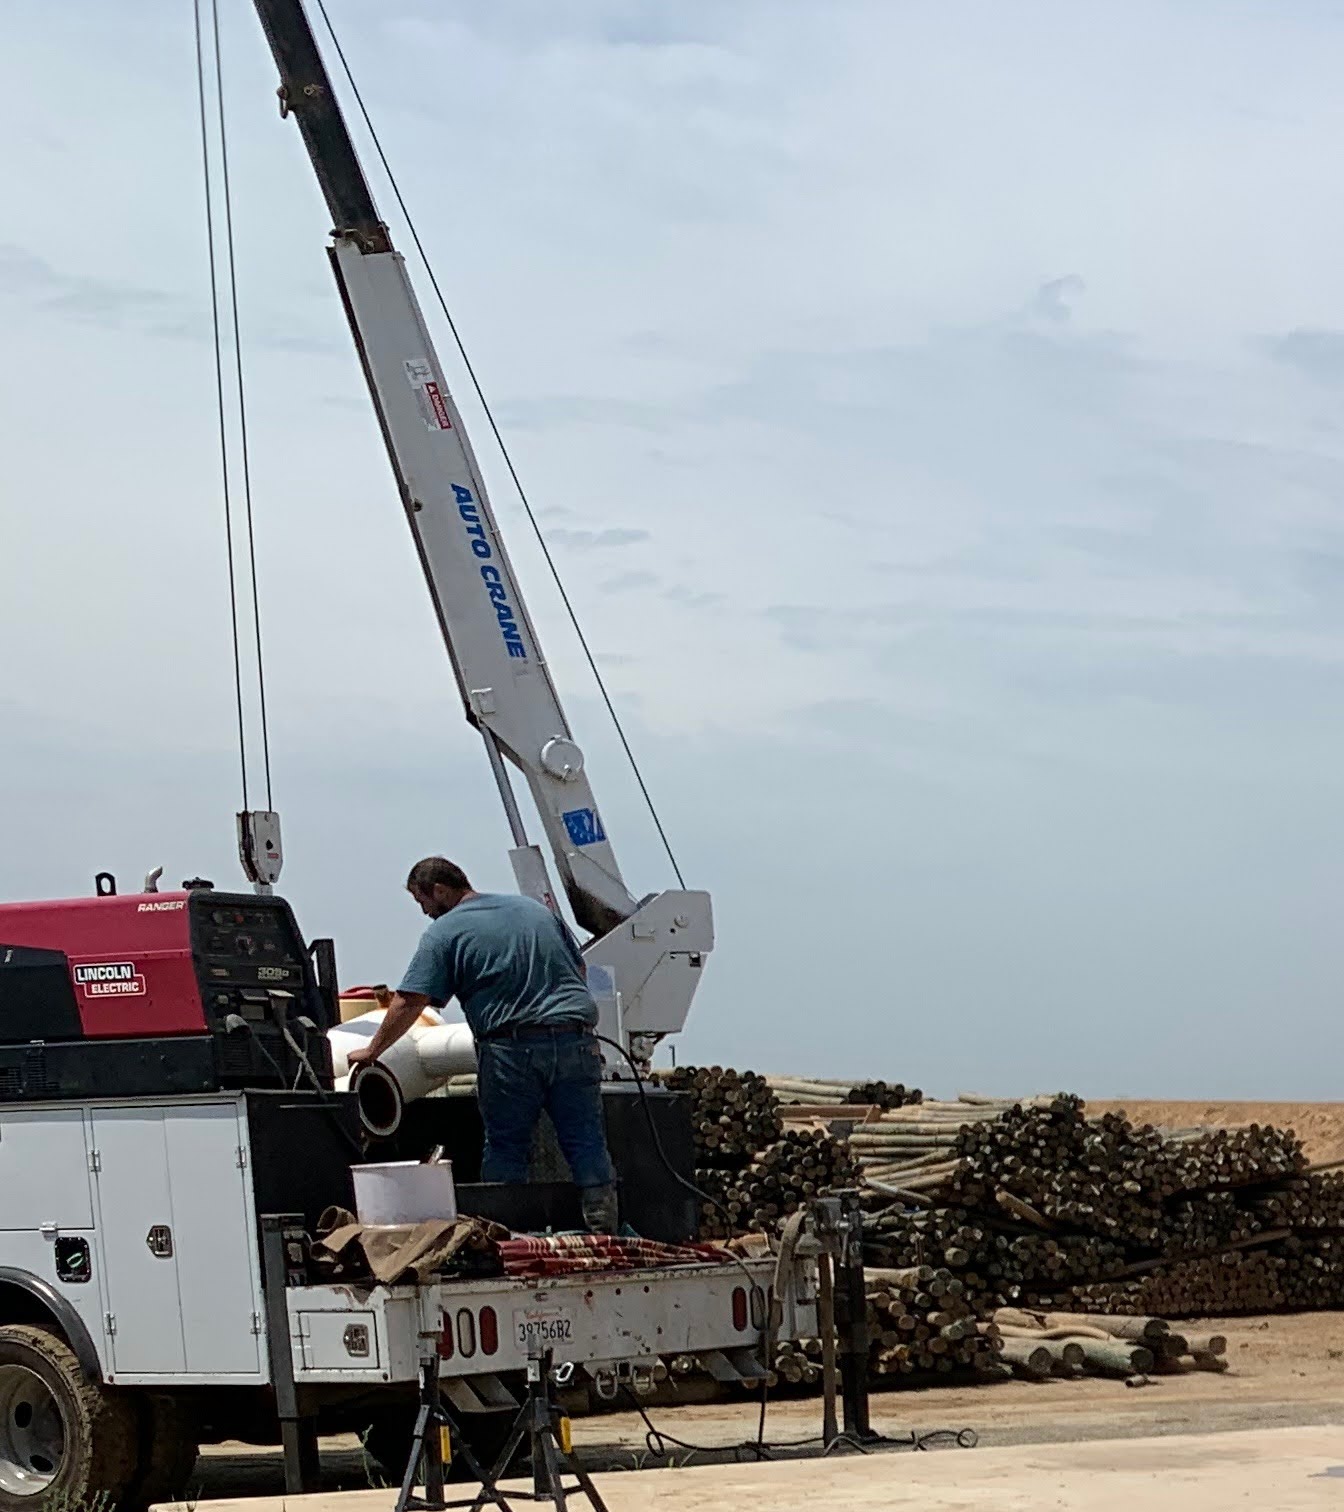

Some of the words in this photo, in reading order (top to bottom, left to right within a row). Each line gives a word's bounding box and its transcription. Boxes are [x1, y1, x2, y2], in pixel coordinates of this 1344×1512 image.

[451, 483, 492, 559] AUTO
[480, 565, 527, 658] CRANE
[137, 901, 184, 912] RANGER
[77, 966, 132, 982] LINCOLN
[91, 981, 140, 994] ELECTRIC
[518, 1319, 571, 1342] 39756B2
